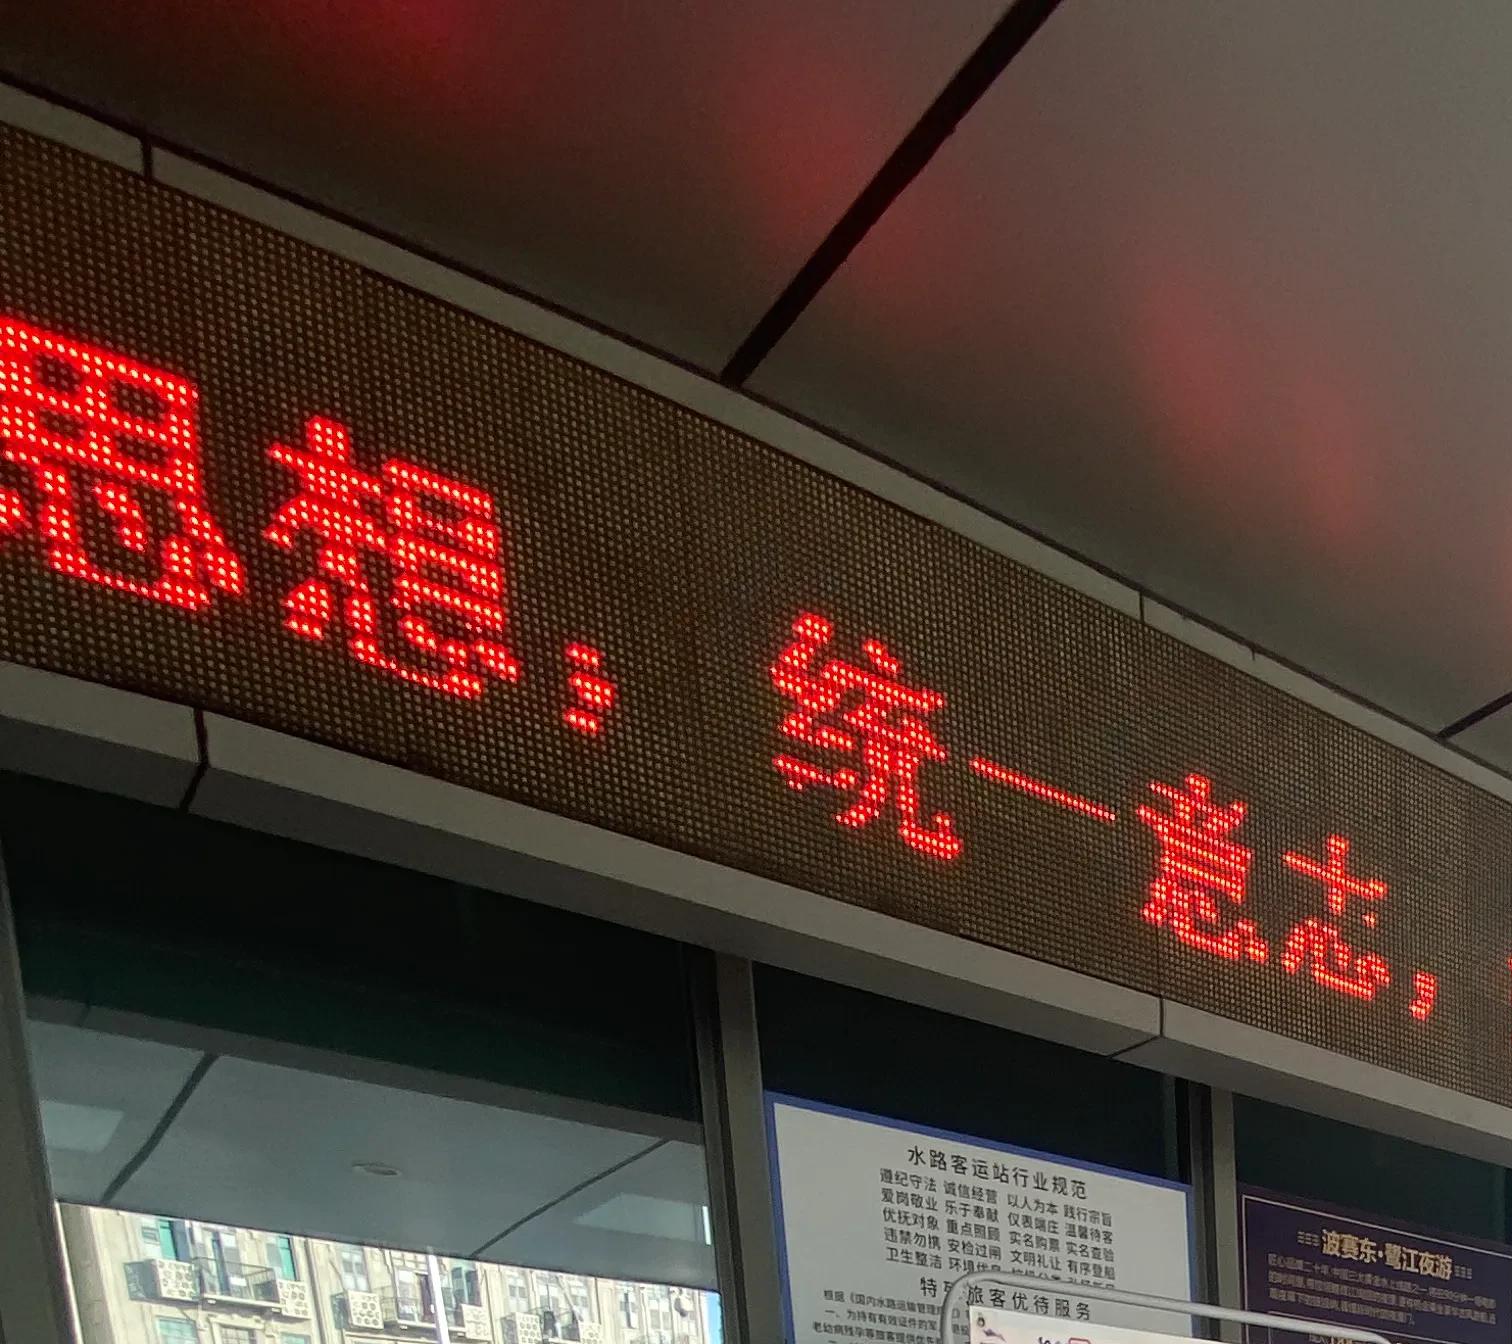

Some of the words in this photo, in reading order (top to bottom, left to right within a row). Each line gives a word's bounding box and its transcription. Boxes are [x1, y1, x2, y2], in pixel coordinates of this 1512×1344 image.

[908, 1145, 1088, 1200] 水路客运站行业规范
